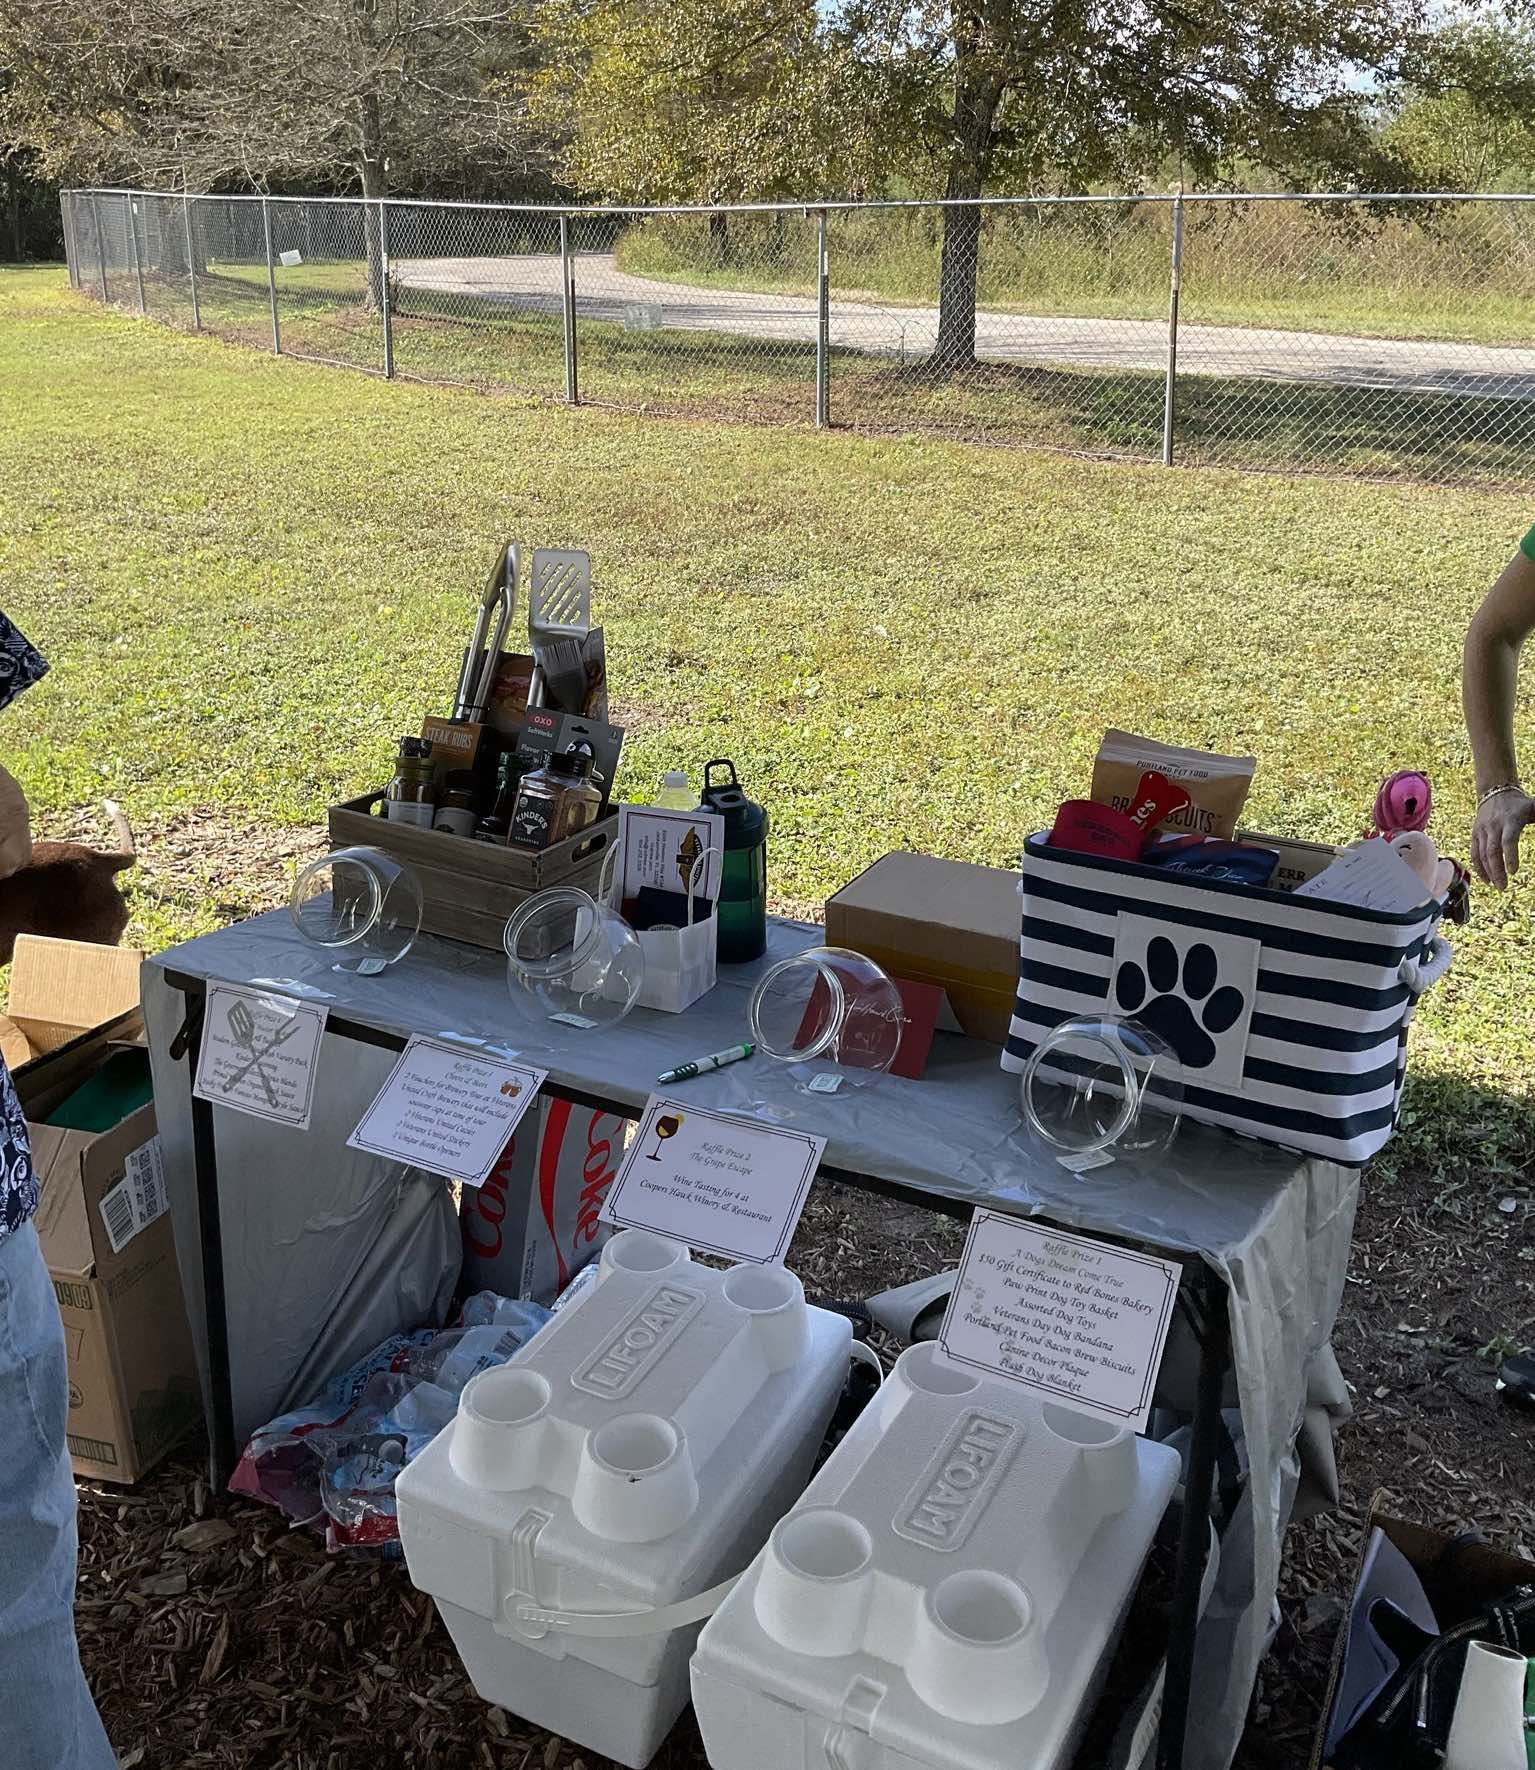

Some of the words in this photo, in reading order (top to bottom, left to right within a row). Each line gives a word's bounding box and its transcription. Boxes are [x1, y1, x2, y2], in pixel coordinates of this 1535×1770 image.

[425, 726, 449, 745] STEAK
[451, 730, 473, 749] RUBS
[534, 716, 552, 726] OXO
[1136, 760, 1172, 774] PORTLAND
[1173, 767, 1189, 777] PET
[1190, 768, 1209, 778] FOOD
[515, 811, 549, 830] KINDERS
[690, 1152, 703, 1162] The
[704, 1156, 726, 1169] Grape
[727, 1162, 753, 1176] Escape
[702, 1142, 724, 1154] Raffle
[725, 1148, 744, 1159] Prize
[573, 1108, 624, 1250] Coke
[674, 1174, 693, 1186] Wine
[694, 1181, 722, 1196] Tasting
[720, 1188, 734, 1198] for
[465, 1136, 516, 1260] Co
[640, 1179, 668, 1193] Coopers
[668, 1188, 693, 1202] Hawk
[694, 1194, 720, 1210] Winery
[731, 1205, 772, 1222] Restaurant
[1042, 1241, 1069, 1256] Raffle
[1072, 1250, 1094, 1263] Prize
[978, 1253, 996, 1265] $50
[996, 1260, 1015, 1272] Gift
[1016, 1265, 1061, 1286] Certificate
[1074, 1282, 1092, 1294] Red
[1094, 1288, 1120, 1303] Bones
[1122, 1297, 1154, 1316] Bakery
[1048, 1258, 1077, 1274] Dream
[1078, 1268, 1102, 1282] Come
[1104, 1274, 1124, 1288] True
[1003, 1277, 1024, 1290] Paw
[1025, 1284, 1048, 1298] Print
[1049, 1291, 1068, 1306] Dog
[1070, 1297, 1086, 1312] Toy
[1088, 1303, 1118, 1320] Basket
[1014, 1298, 1055, 1316] Assorted
[1056, 1310, 1074, 1325] Dog
[1076, 1315, 1096, 1330] Toys
[588, 1286, 692, 1389] LIFOAM
[963, 1310, 1003, 1334] Portland
[1003, 1326, 1018, 1338] Pet
[1020, 1331, 1044, 1345] Food
[1044, 1339, 1072, 1355] Bacon
[1074, 1349, 1098, 1363] Brew
[1099, 1356, 1136, 1376] Biscuits
[994, 1306, 1030, 1325] Veterans
[1032, 1319, 1051, 1334] Day
[1053, 1325, 1072, 1341] Dog
[1074, 1332, 1114, 1351] Bandana
[999, 1341, 1030, 1358] Canine
[1031, 1352, 1058, 1366] Decor
[1060, 1360, 1090, 1378] Plaque
[999, 1355, 1025, 1374] Plush
[1026, 1366, 1045, 1382] Dog
[1047, 1374, 1082, 1393] Blanket
[910, 1412, 1007, 1538] LIFOAM
